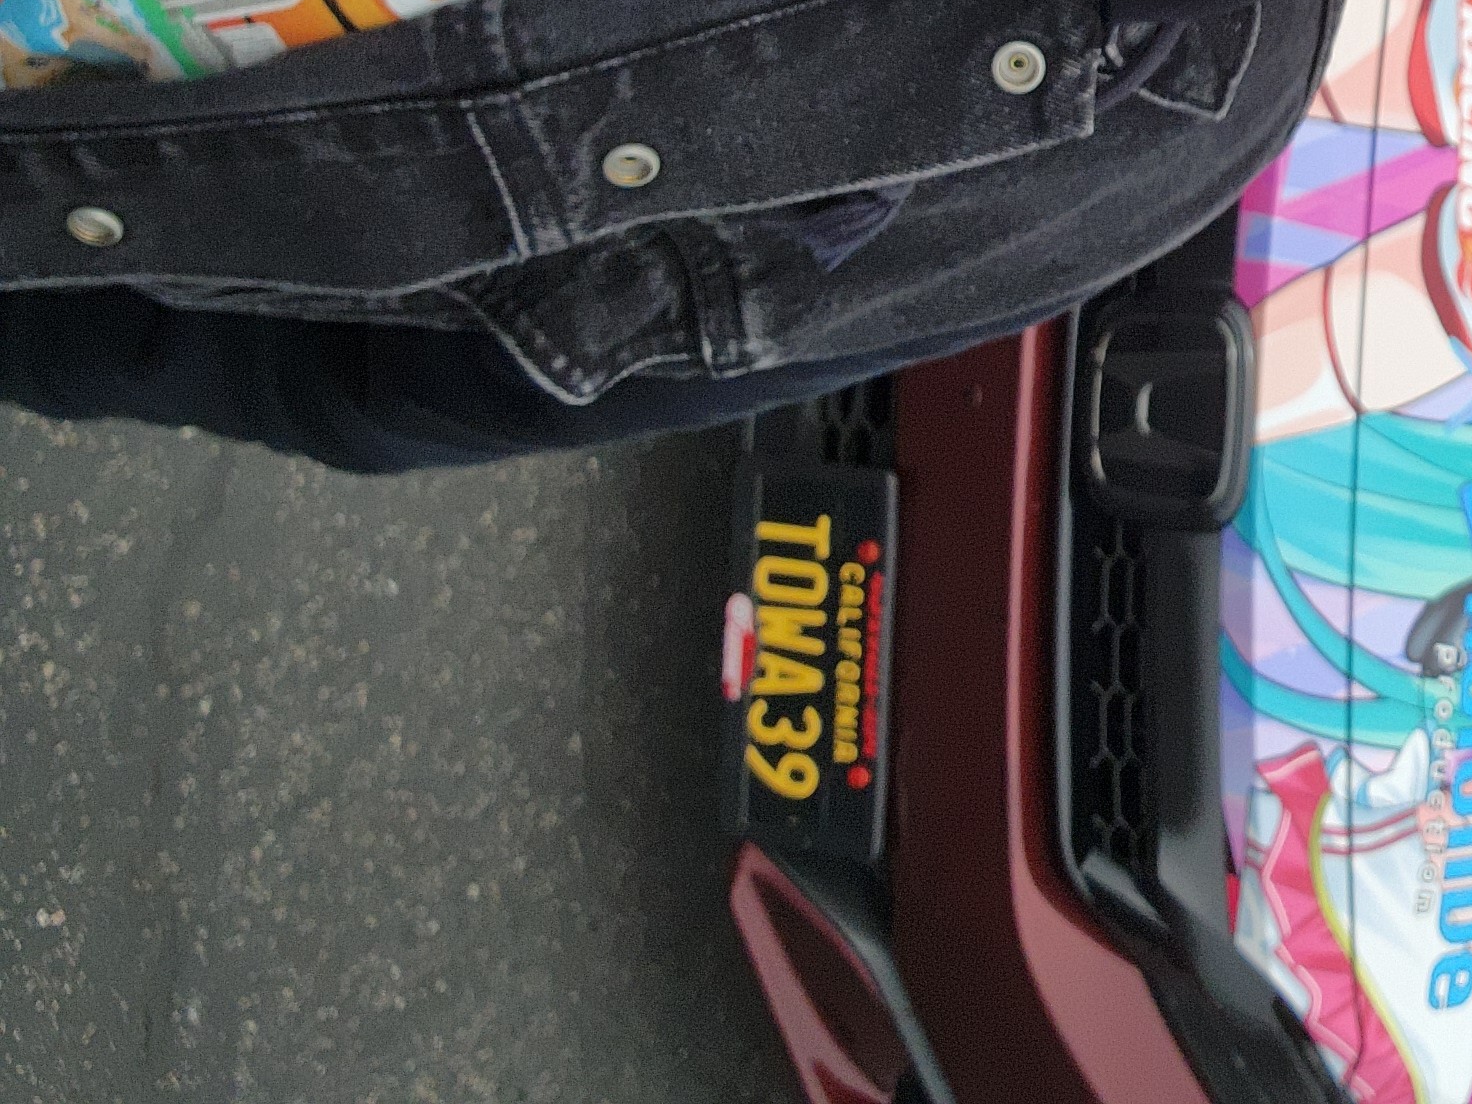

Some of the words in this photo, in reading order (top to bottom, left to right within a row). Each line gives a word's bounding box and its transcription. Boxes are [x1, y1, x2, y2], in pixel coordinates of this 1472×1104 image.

[743, 513, 833, 801] TOWA39
[831, 561, 867, 764] CALIFORNIA
[1414, 643, 1459, 916] production
